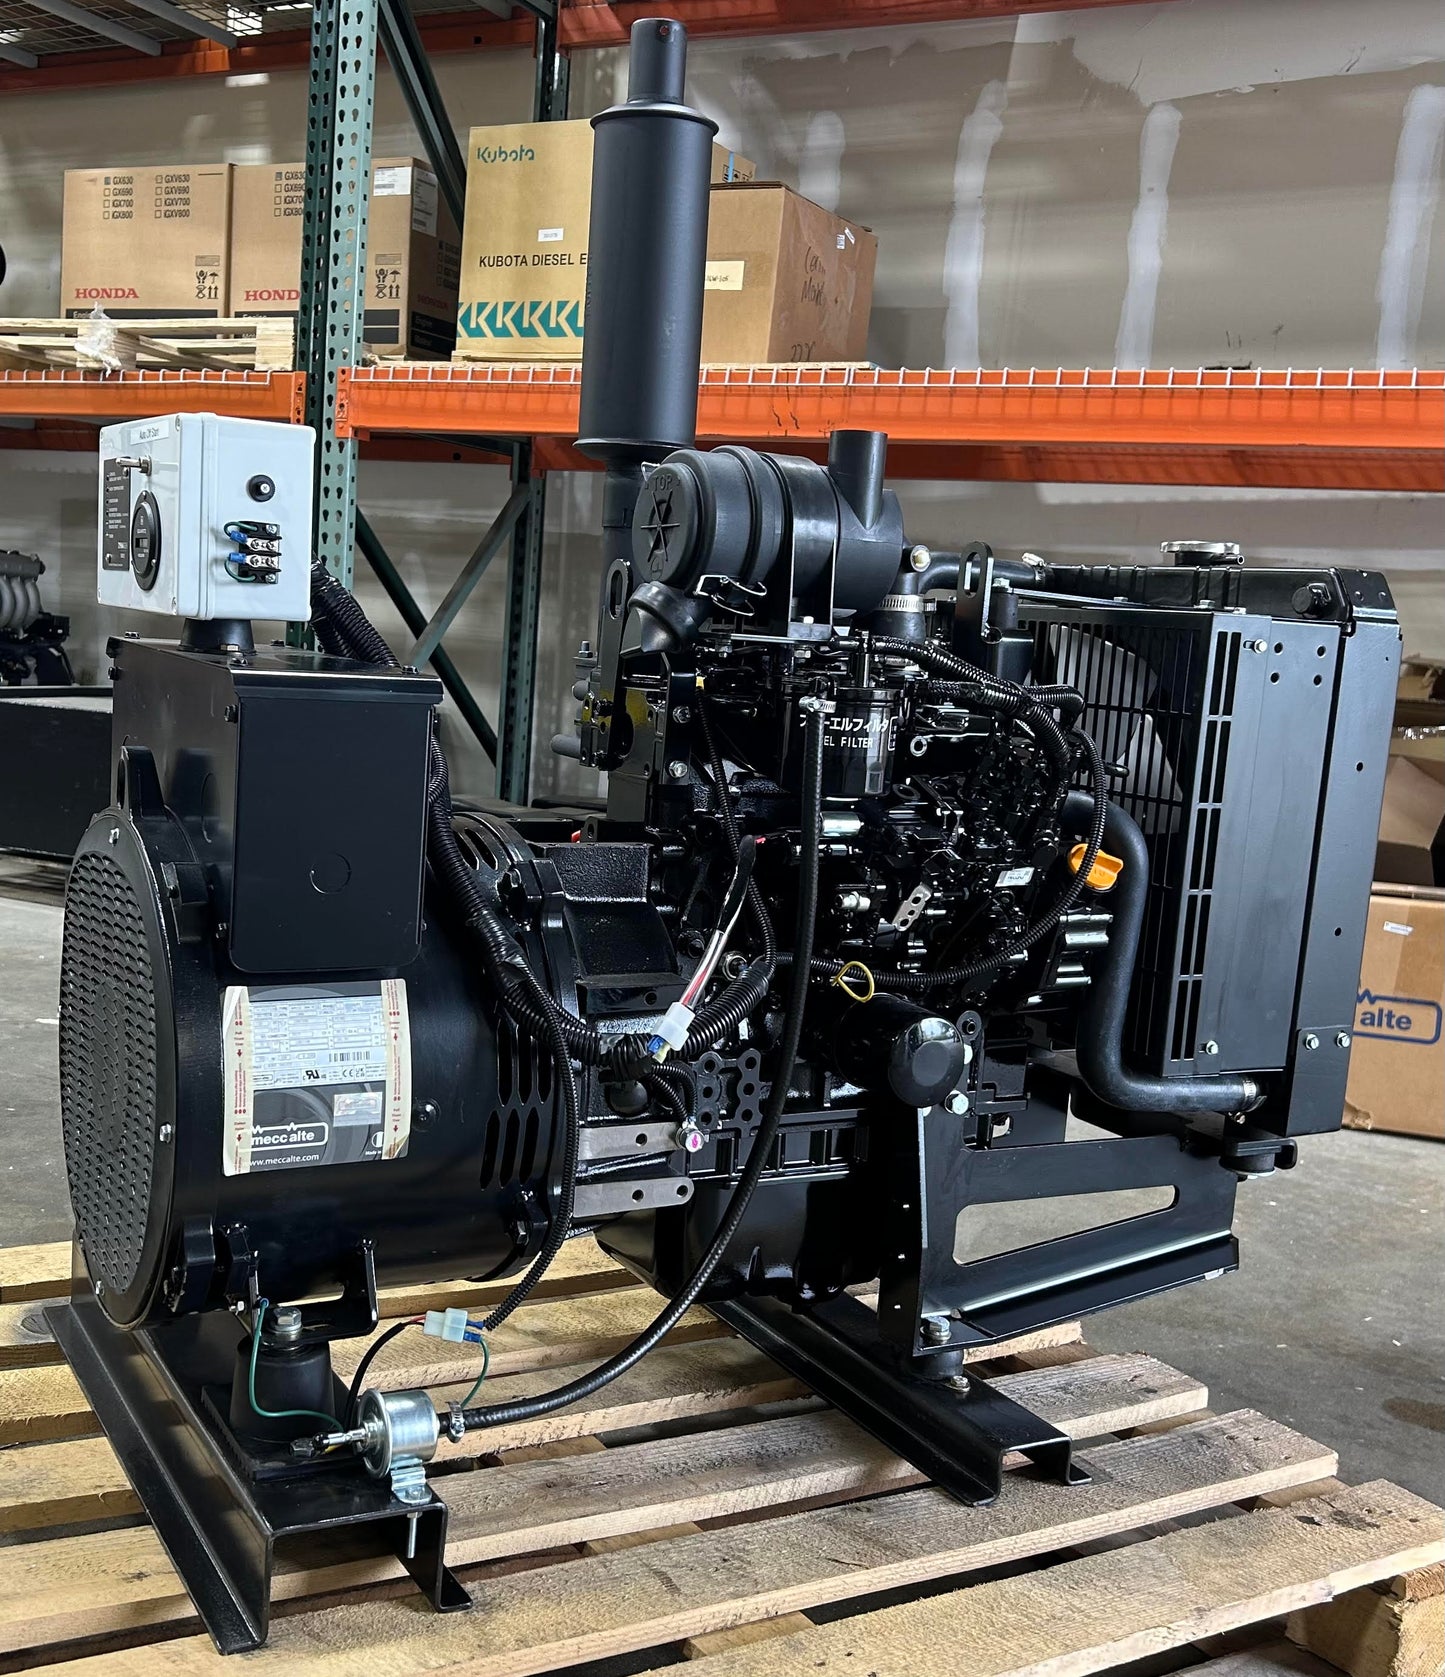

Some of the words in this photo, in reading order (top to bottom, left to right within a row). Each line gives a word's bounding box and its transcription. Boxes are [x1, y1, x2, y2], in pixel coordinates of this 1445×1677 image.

[477, 144, 535, 163] Kubota
[113, 176, 134, 185] GX630
[165, 174, 191, 184] GXV630
[112, 187, 133, 197] GX690
[283, 195, 304, 204] iGX70
[282, 207, 303, 217] iGX80
[479, 254, 528, 268] KUBOTA
[532, 253, 575, 267] DIESEL
[75, 288, 140, 299] HONDA
[244, 289, 301, 301] HOND
[653, 473, 673, 491] TOP
[841, 737, 873, 749] FILTER
[1360, 1007, 1412, 1031] alte
